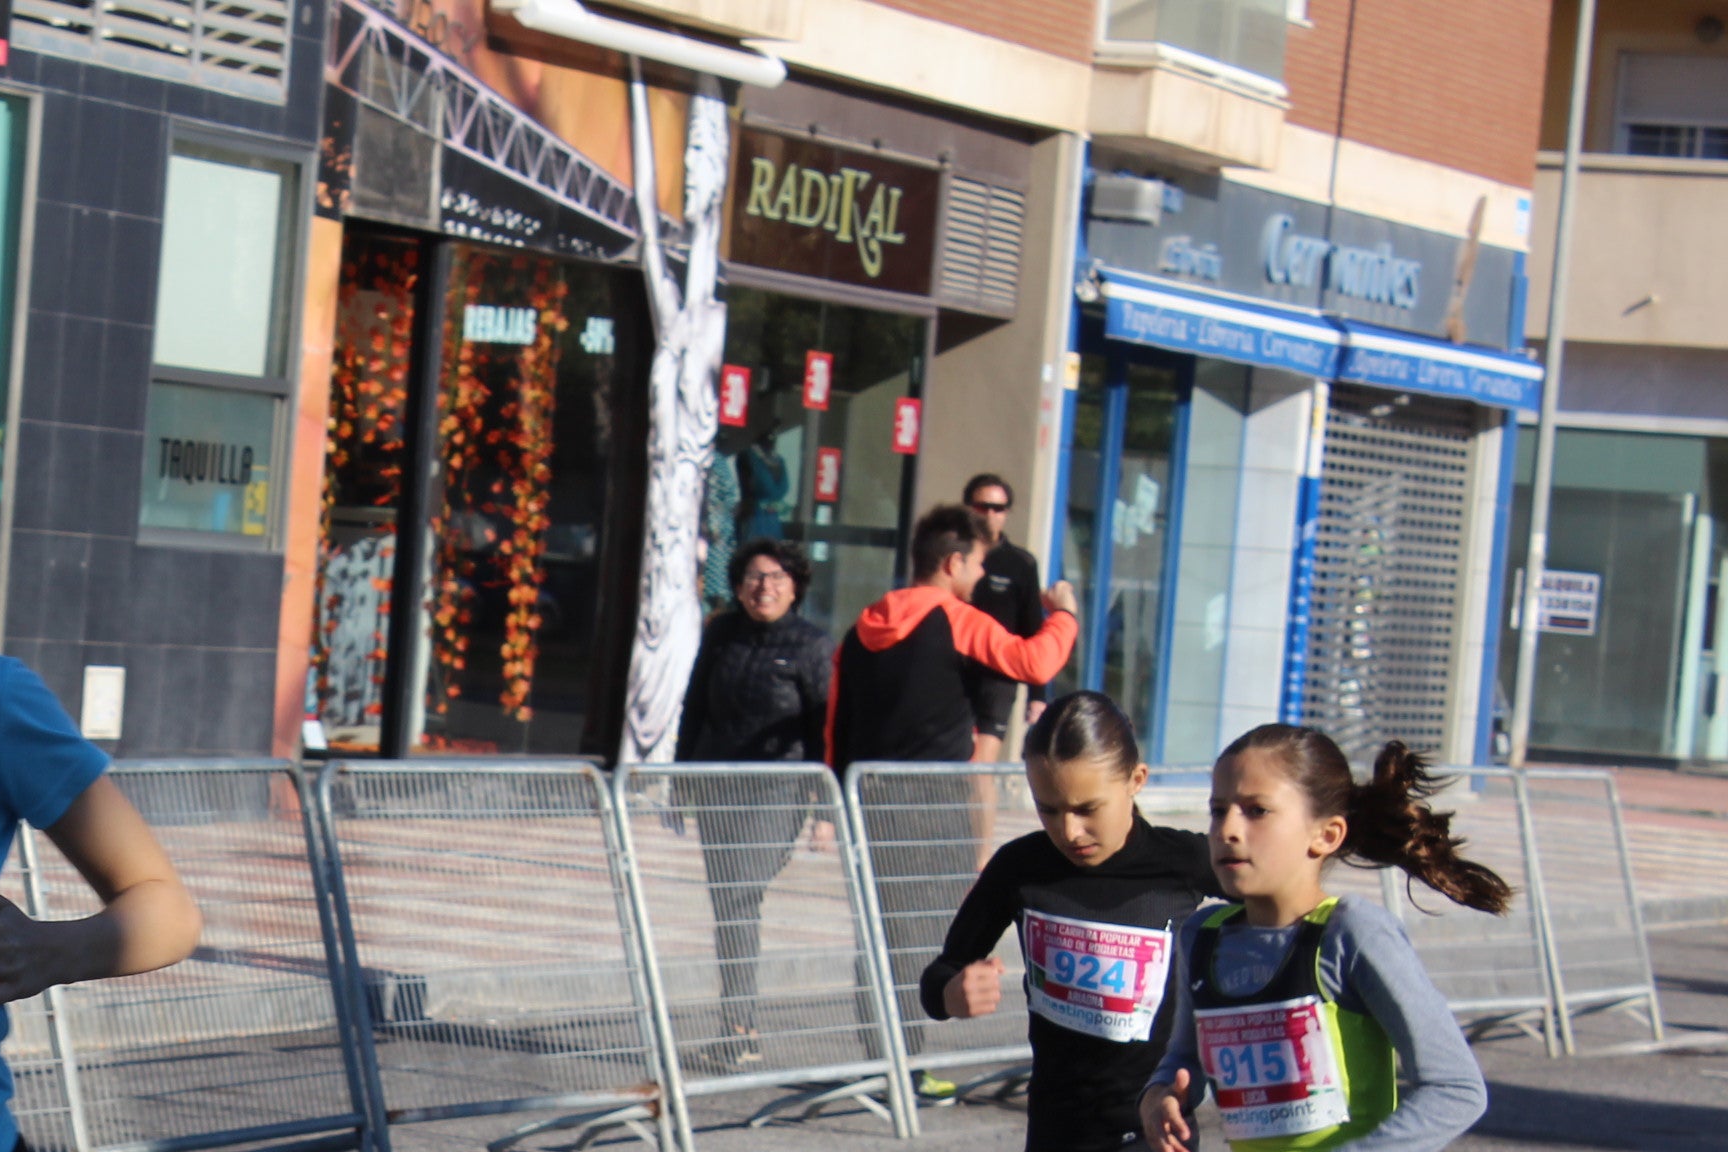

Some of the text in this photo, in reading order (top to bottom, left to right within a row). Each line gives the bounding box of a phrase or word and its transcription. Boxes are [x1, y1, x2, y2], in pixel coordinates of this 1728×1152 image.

[745, 156, 906, 278] RADIKAL
[159, 437, 254, 486] TAQUILLA
[1075, 939, 1086, 951] DE
[1088, 943, 1136, 959] ROQUETAS
[1099, 931, 1142, 946] POPULAR
[1054, 950, 1126, 994] 924
[1041, 995, 1135, 1028] meetingpoint
[1246, 1011, 1287, 1027] POPULAR
[1218, 1041, 1287, 1088] 915
[1221, 1101, 1316, 1126] eetingpoint
